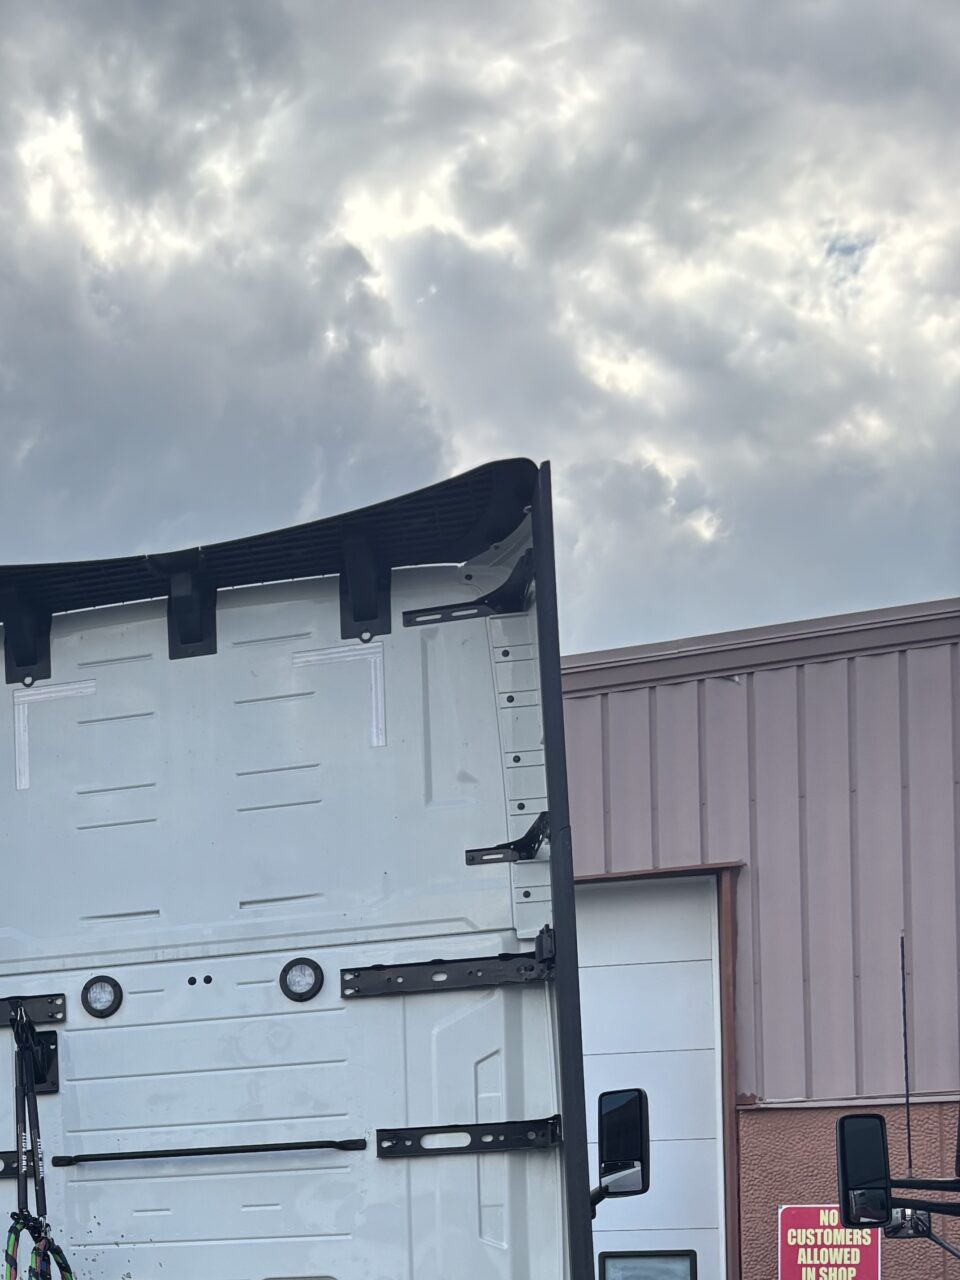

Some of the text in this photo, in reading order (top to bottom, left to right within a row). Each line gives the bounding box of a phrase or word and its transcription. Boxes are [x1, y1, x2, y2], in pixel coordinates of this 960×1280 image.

[819, 1209, 839, 1226] NO
[787, 1228, 872, 1246] CUSTOMERS
[797, 1248, 861, 1265] ALLOWED
